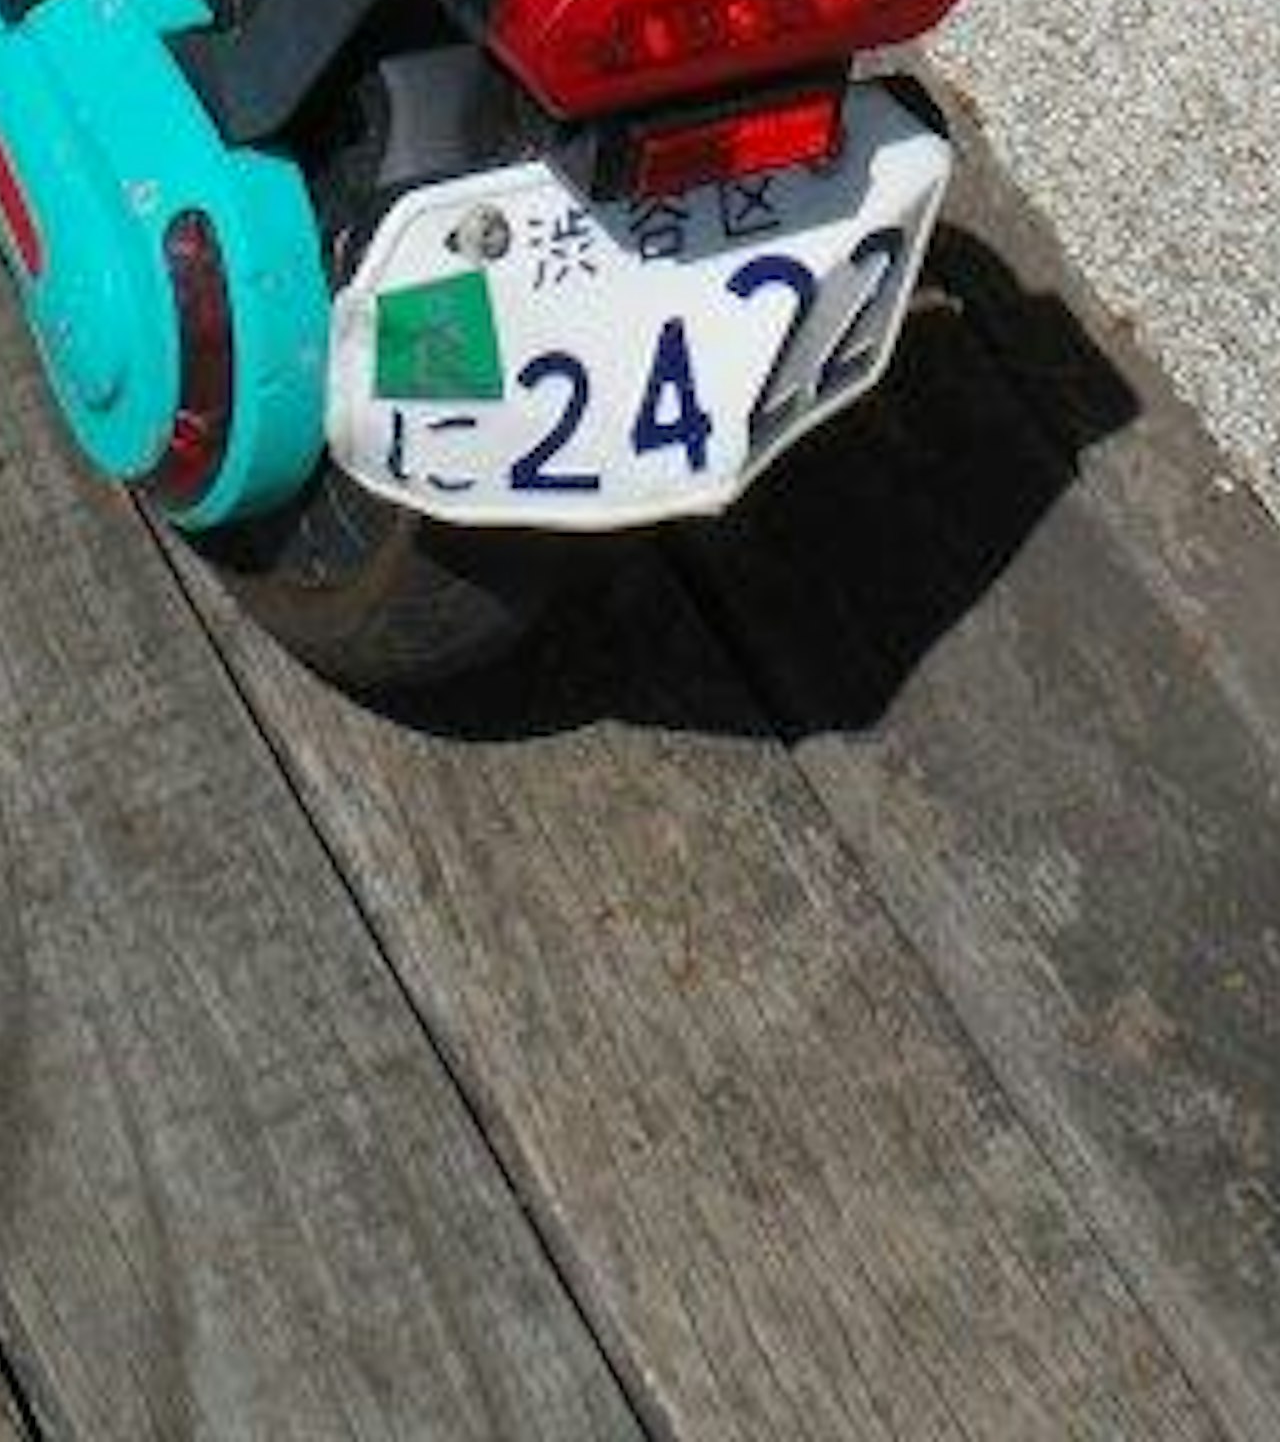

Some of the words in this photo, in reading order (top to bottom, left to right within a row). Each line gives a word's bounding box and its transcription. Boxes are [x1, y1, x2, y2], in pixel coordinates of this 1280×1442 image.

[528, 174, 780, 288] 渋谷区
[387, 411, 477, 491] に
[510, 226, 906, 490] 2422
